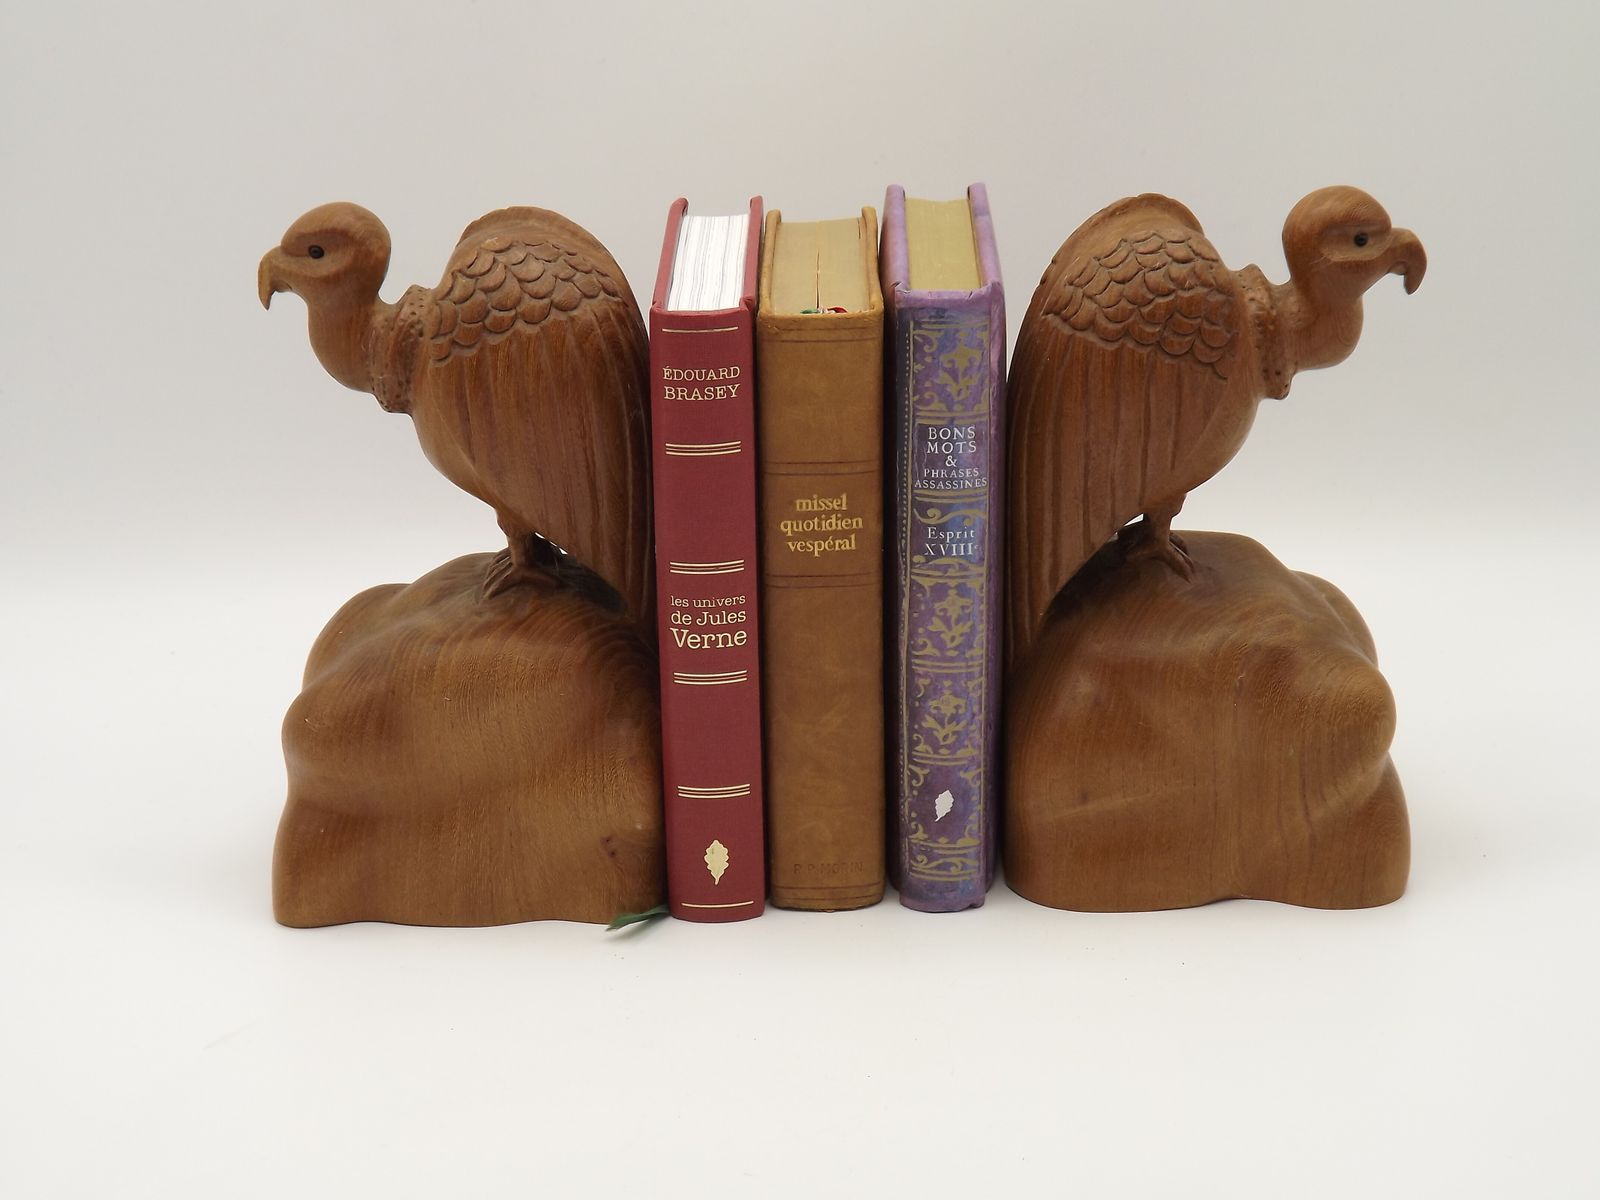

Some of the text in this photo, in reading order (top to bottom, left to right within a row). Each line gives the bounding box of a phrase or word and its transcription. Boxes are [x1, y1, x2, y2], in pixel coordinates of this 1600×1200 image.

[662, 365, 741, 381] ÉDOUARD
[663, 383, 741, 401] BRASEY
[928, 425, 976, 440] BONS
[926, 440, 977, 454] MOTS
[945, 455, 957, 467] &
[924, 467, 979, 478] PHRASES
[914, 477, 988, 490] ASSASSINES
[795, 492, 848, 512] missel
[780, 513, 864, 537] quotidien
[927, 526, 976, 543] Esprit
[787, 533, 857, 557] vespéral
[670, 595, 746, 608] les univers
[671, 610, 747, 626] de Jules
[669, 627, 747, 649] Verne
